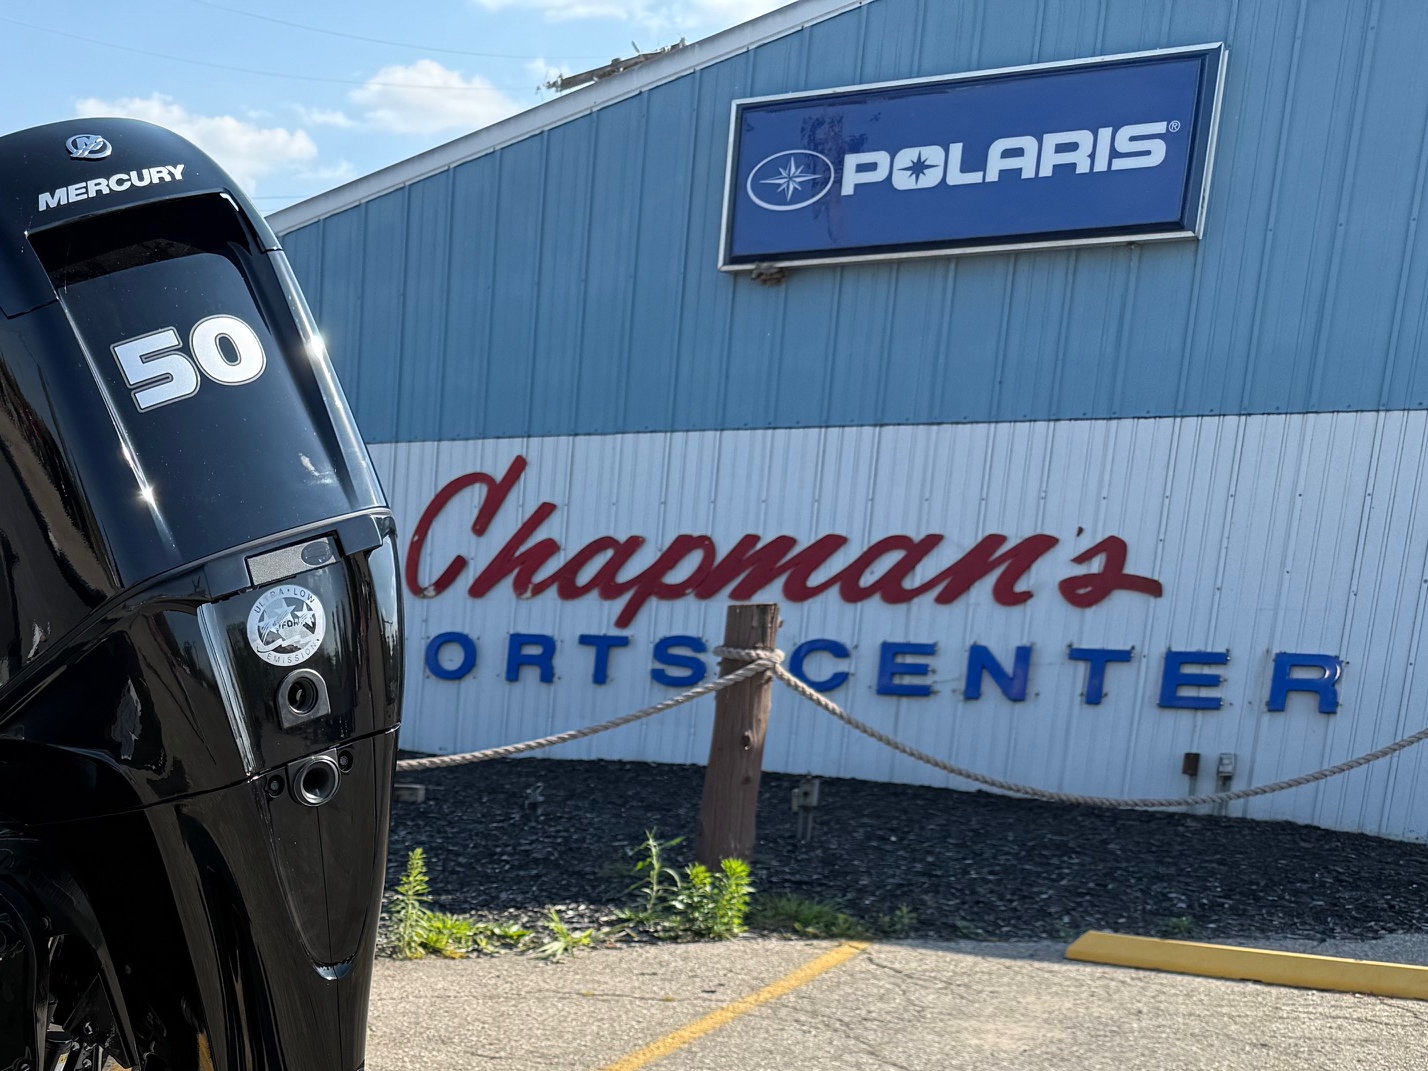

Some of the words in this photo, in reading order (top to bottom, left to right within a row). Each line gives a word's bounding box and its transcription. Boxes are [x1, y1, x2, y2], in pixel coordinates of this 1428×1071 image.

[38, 164, 185, 212] MERCURY
[110, 314, 267, 413] 50
[405, 454, 1163, 629] Chapman's
[253, 588, 285, 614] ULTRA
[293, 589, 315, 603] LOW
[266, 643, 317, 664] EMISSION
[424, 631, 709, 688] ORTS
[788, 638, 1344, 714] CENTER
